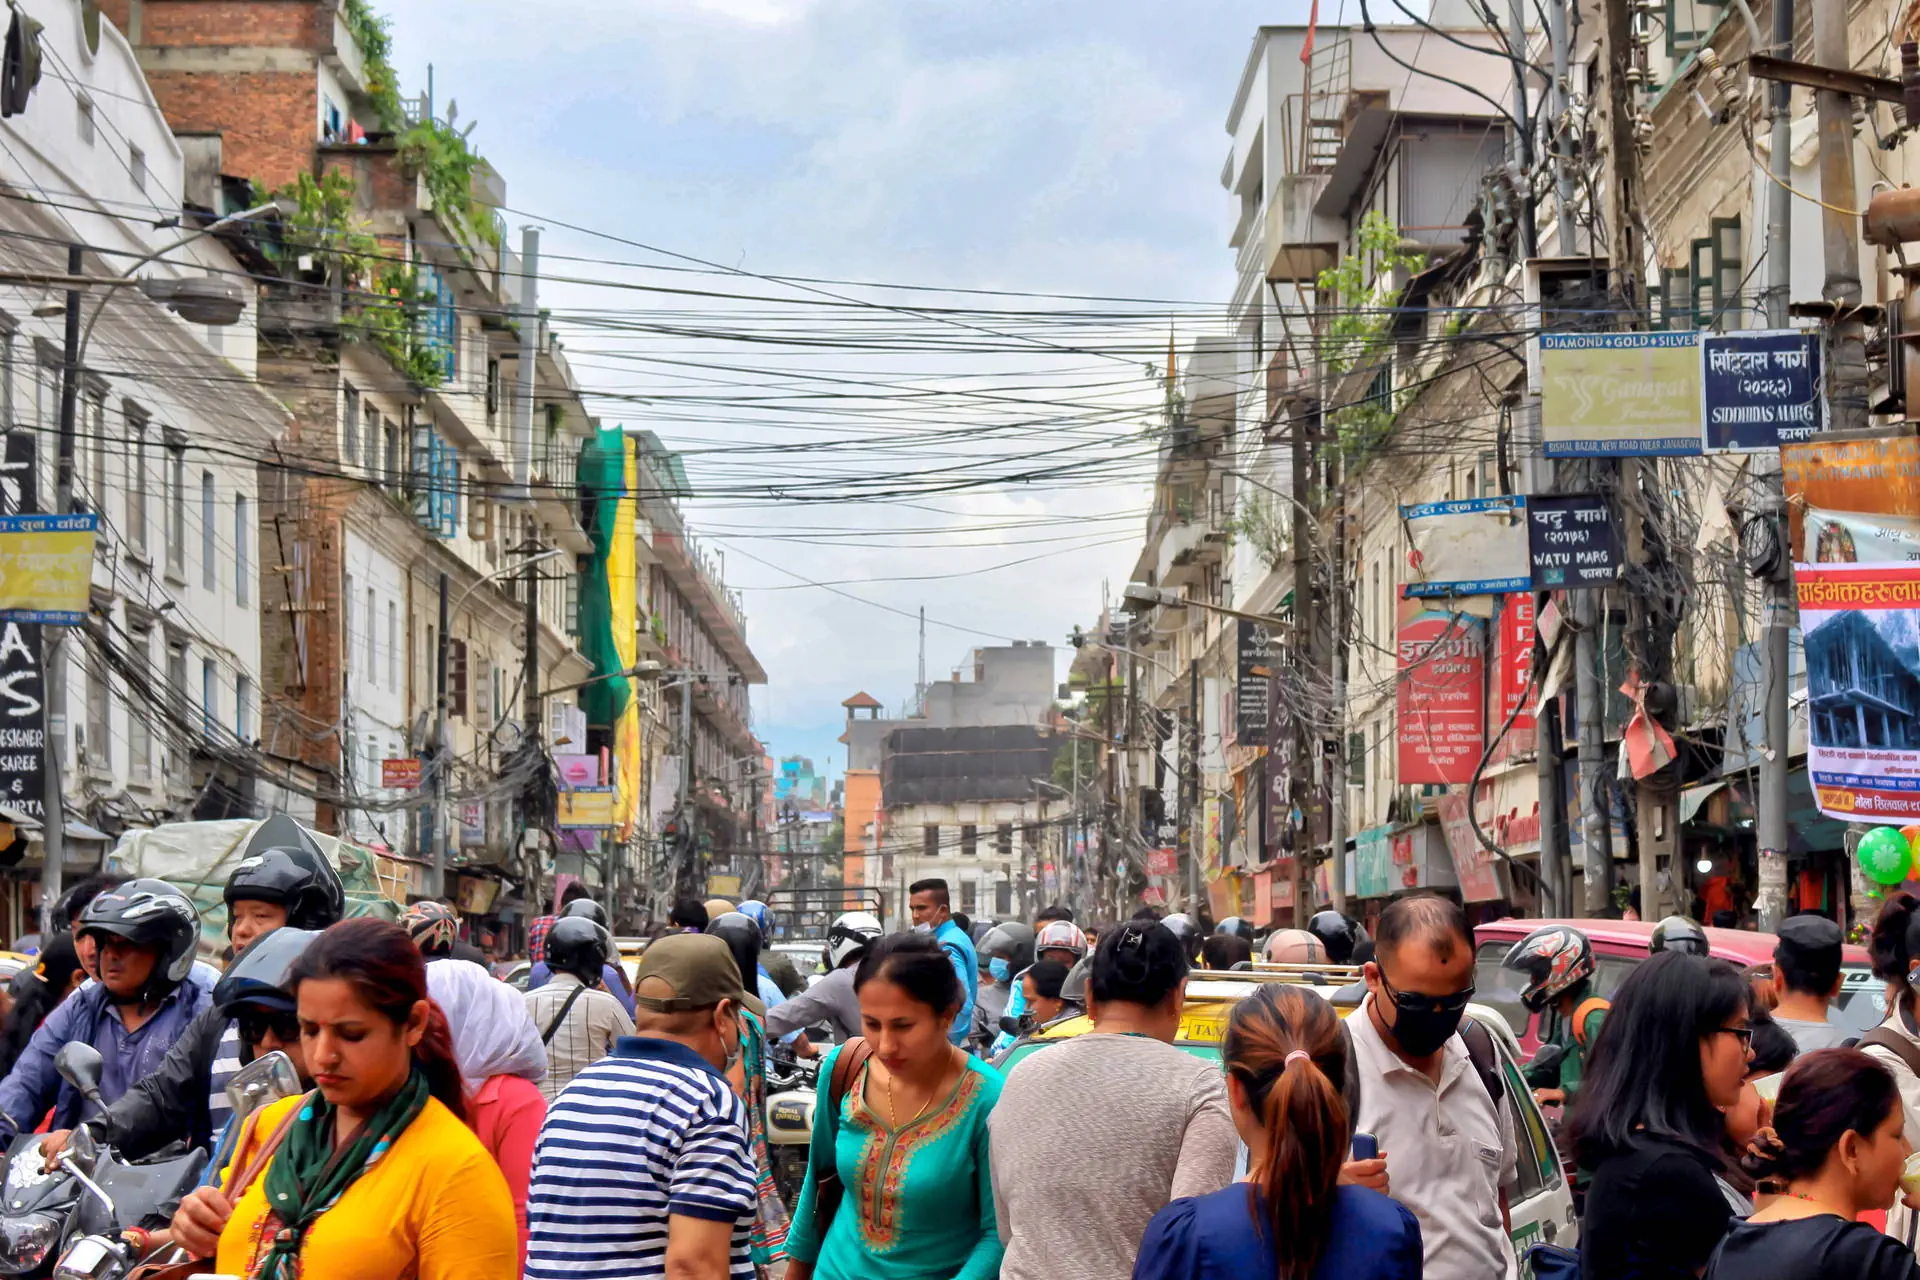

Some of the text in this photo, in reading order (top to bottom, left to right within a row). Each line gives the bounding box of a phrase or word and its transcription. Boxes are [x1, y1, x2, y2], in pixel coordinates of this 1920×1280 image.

[1546, 334, 1699, 348] DIAMOND GOLD SILVER
[1711, 404, 1814, 423] SIDDHIDAS MARG
[1548, 442, 1572, 452] BISHAL
[1601, 441, 1618, 451] NEW
[1619, 440, 1638, 450] ROAD
[1533, 550, 1608, 568] WATU MARG
[0, 728, 43, 748] ESIGNER
[0, 755, 37, 772] SAREE
[11, 778, 23, 793] &
[4, 799, 45, 816] URTA
